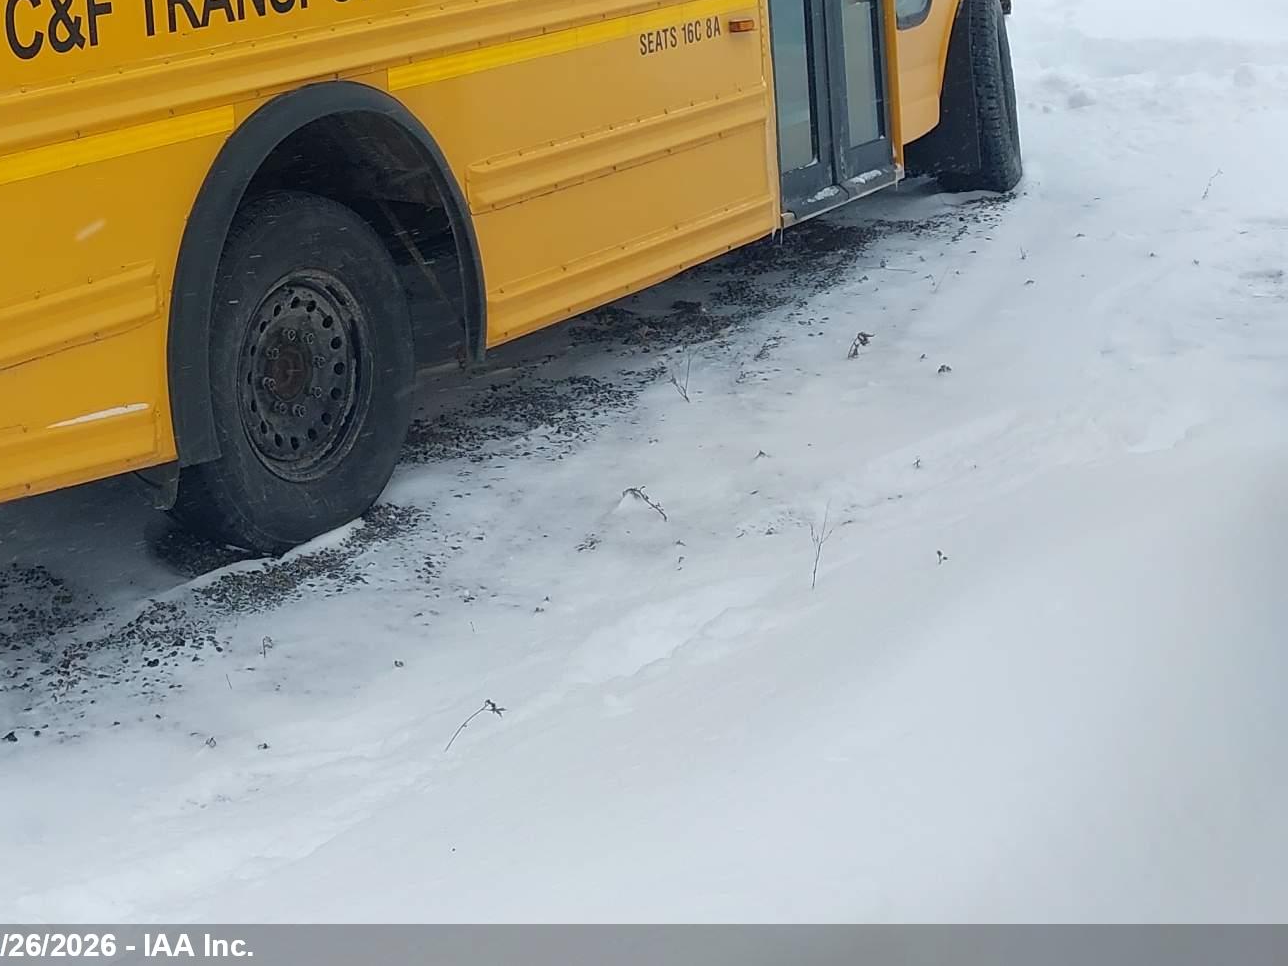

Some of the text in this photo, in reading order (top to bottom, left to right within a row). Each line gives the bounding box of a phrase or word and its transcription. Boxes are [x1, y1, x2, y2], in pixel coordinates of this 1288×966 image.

[639, 15, 721, 56] SEATS 16C 8A
